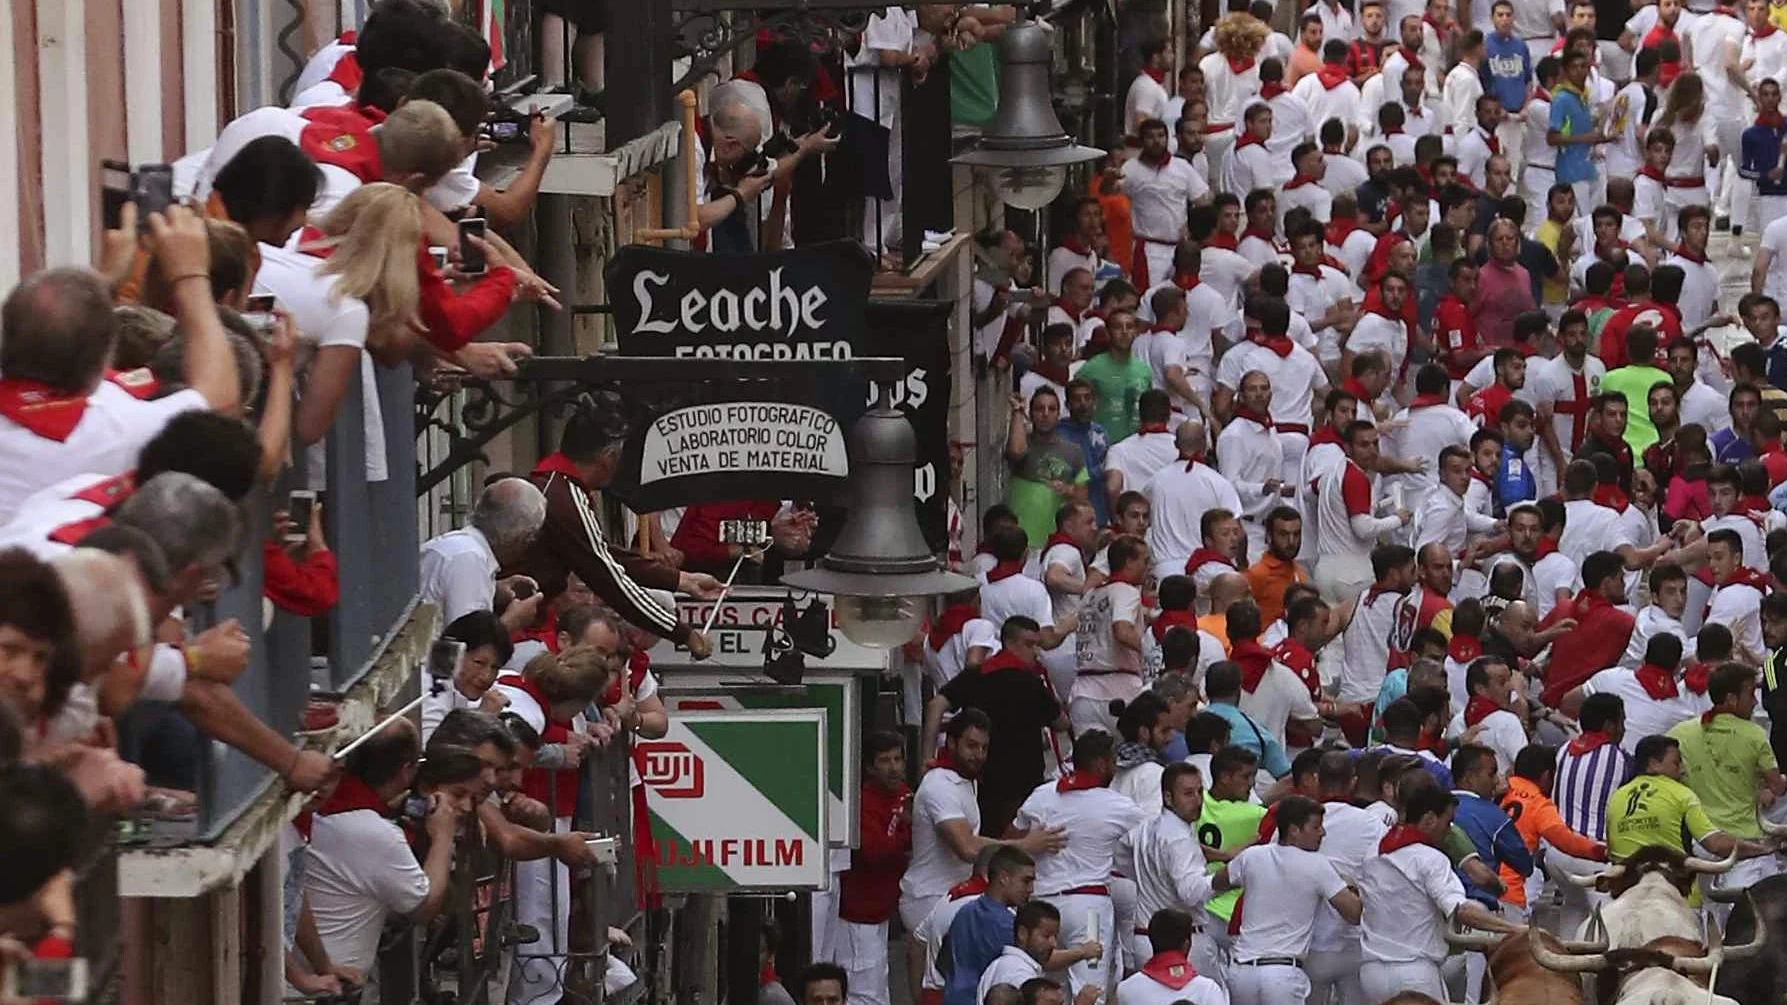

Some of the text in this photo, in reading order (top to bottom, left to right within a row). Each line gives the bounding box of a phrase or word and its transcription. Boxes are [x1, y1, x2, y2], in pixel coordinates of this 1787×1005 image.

[632, 266, 828, 338] Leache
[656, 406, 836, 437] ESTUDIO FOTOGRAFICO
[667, 426, 828, 456] LABORATORIO COLOR
[657, 450, 829, 476] VENTA DE MATERIAL
[655, 839, 803, 867] UJIFILM
